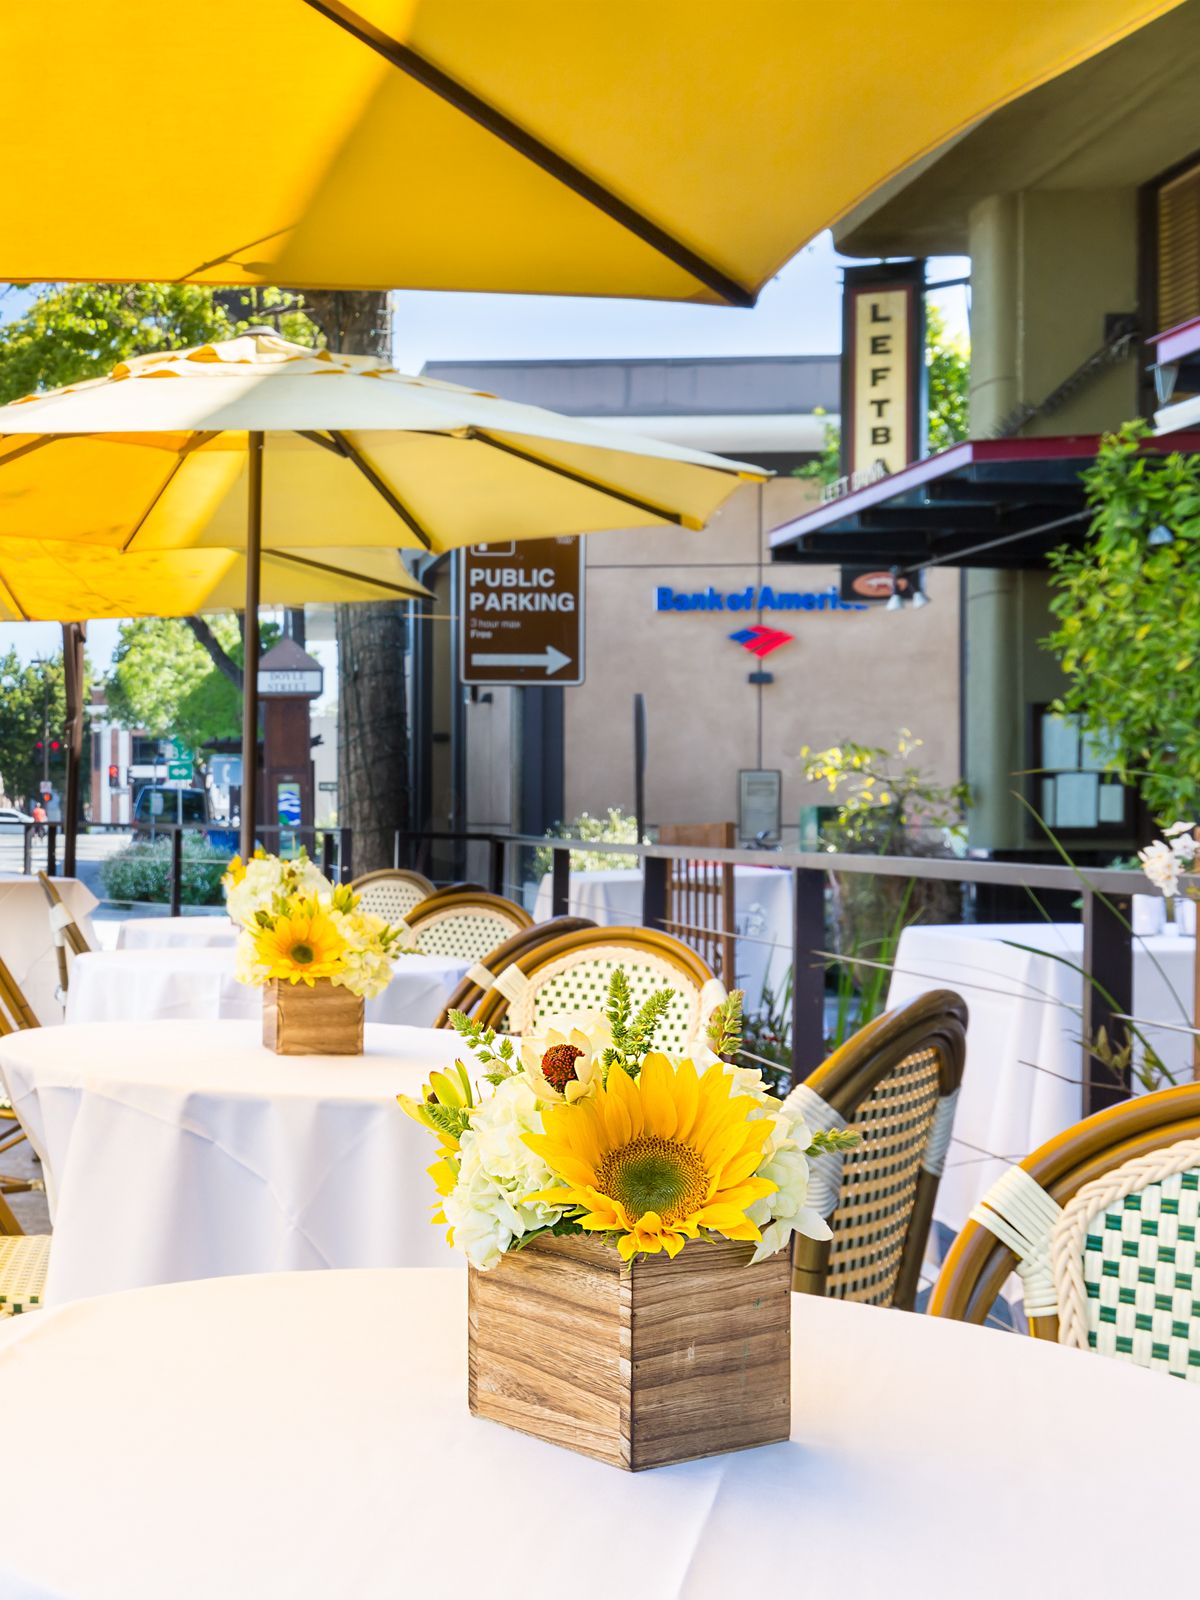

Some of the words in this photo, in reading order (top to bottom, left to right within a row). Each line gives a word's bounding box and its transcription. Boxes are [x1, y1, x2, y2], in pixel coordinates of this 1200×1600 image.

[470, 568, 555, 588] PUBLIC
[470, 592, 575, 612] PARKING
[655, 586, 723, 612] Bank
[726, 587, 753, 611] of
[756, 586, 869, 611] Ameri
[470, 629, 492, 639] Free
[478, 619, 499, 629] hour
[501, 620, 521, 629] max
